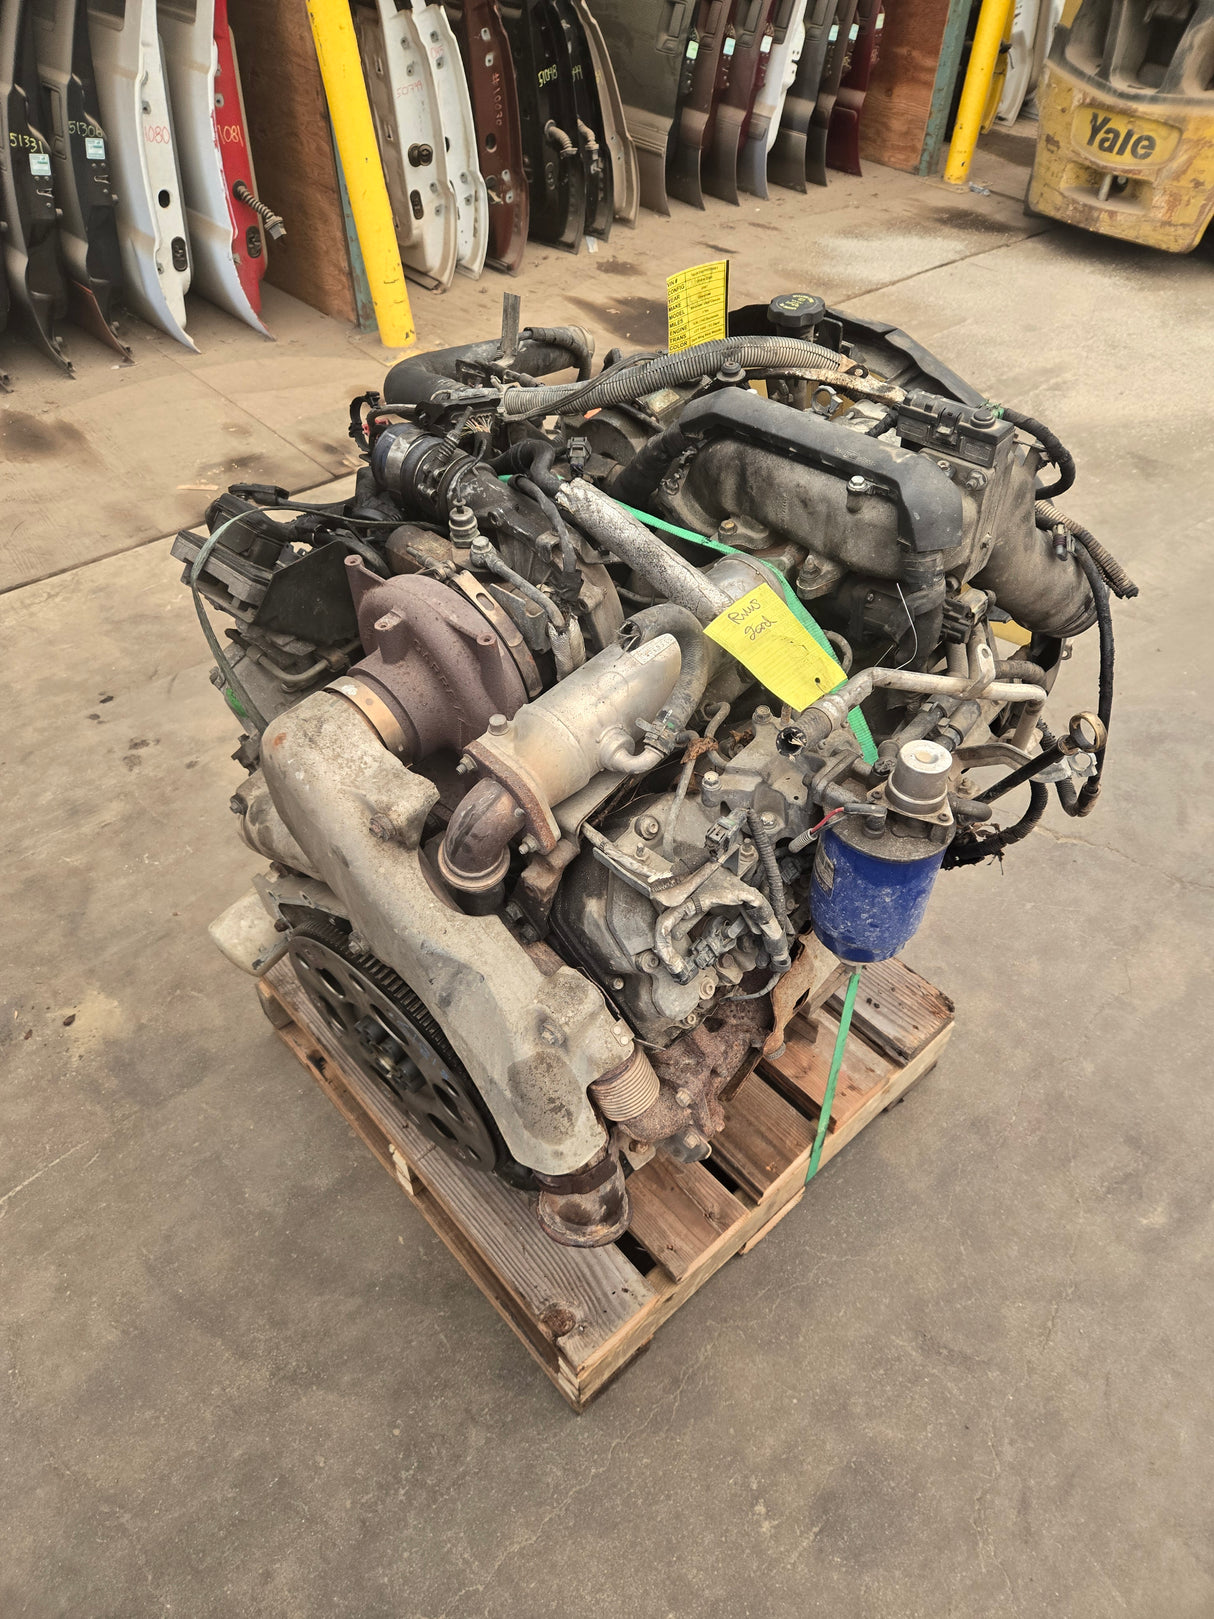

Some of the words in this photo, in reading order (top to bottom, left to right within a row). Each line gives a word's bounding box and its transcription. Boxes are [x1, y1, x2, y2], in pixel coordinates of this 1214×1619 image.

[217, 125, 244, 147] 1081
[1086, 112, 1157, 160] Yale
[9, 132, 44, 154] 51331
[667, 284, 685, 296] CONFIG
[668, 294, 681, 304] YEAR
[668, 303, 682, 312] MAKE
[669, 310, 685, 320] MODEL
[669, 318, 683, 328] MILES
[669, 325, 688, 336] ENGINE
[669, 334, 687, 343] TRANS
[669, 341, 688, 351] COLOR
